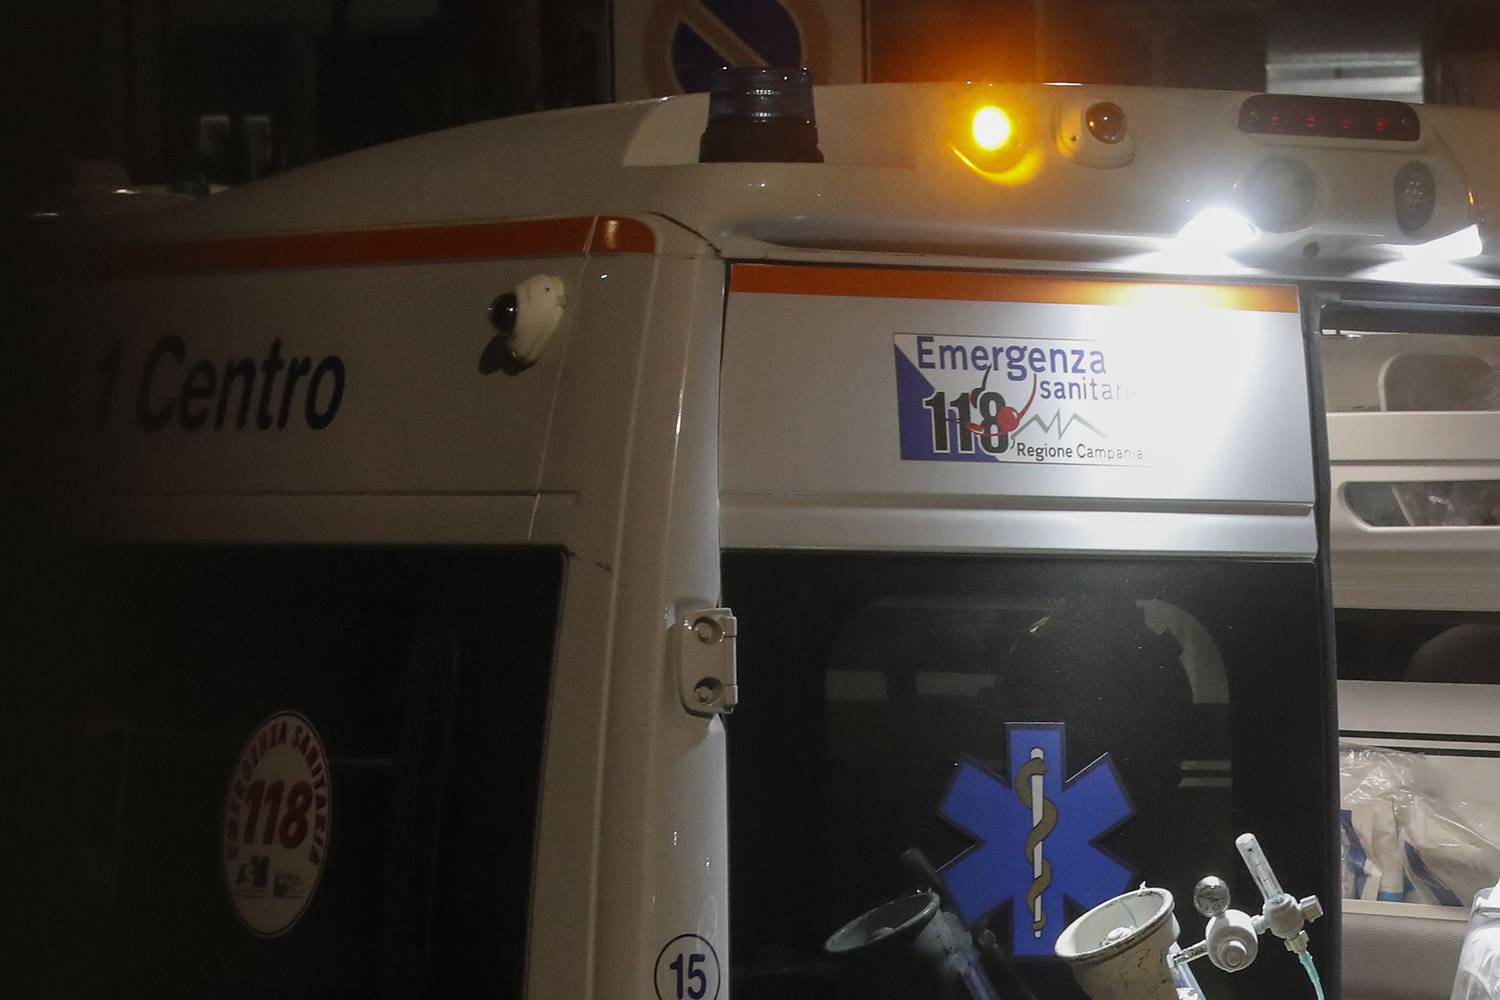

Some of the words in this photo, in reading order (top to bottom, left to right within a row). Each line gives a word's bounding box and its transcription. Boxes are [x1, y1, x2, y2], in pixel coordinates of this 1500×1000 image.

[137, 334, 346, 432] Centro
[917, 336, 1107, 381] Emergenza
[923, 391, 1010, 454] 118
[1017, 442, 1073, 462] Regione
[1076, 443, 1143, 461] Campania
[244, 780, 313, 849] 118
[669, 953, 707, 1000] 15
